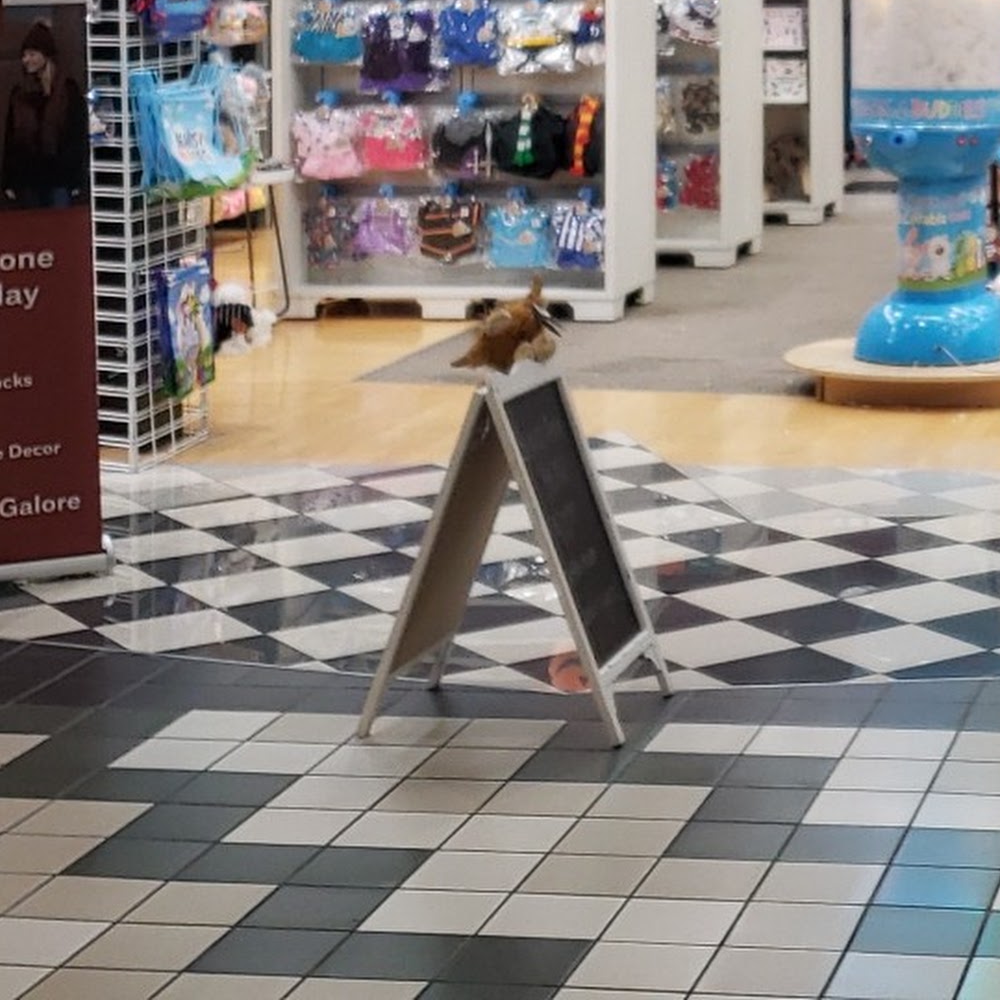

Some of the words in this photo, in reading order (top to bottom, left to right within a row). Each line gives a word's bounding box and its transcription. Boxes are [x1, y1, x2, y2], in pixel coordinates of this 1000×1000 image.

[0, 250, 54, 272] one
[0, 372, 33, 390] cks
[8, 443, 62, 460] Decor
[0, 494, 82, 519] Galore
